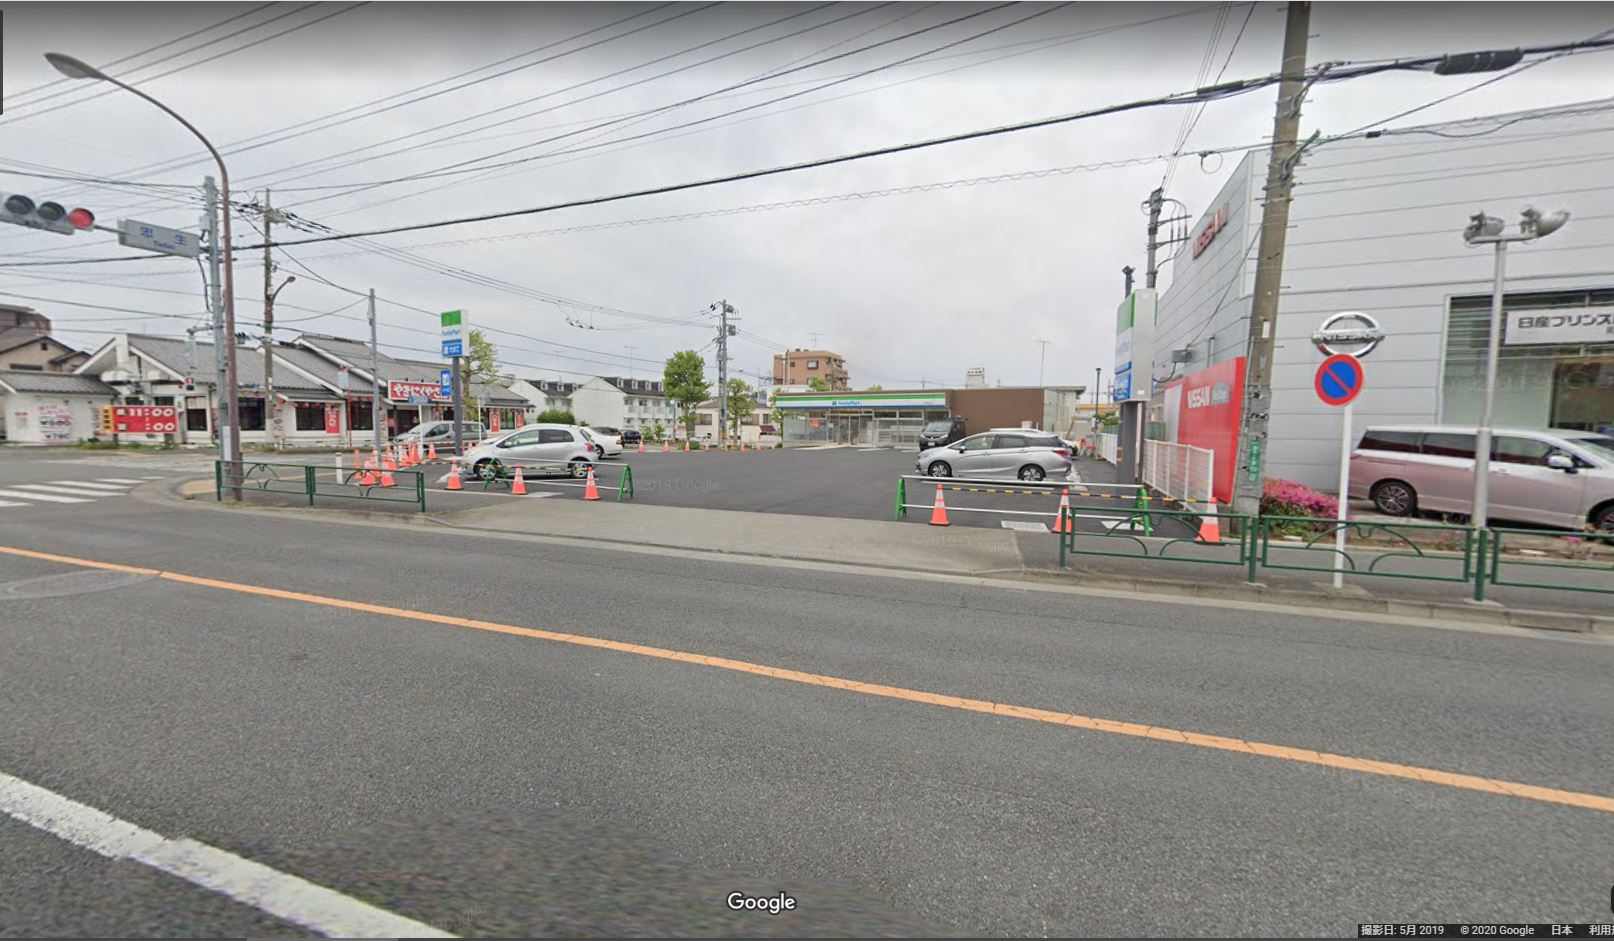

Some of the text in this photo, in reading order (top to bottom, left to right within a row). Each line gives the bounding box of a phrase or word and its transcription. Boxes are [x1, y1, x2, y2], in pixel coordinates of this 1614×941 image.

[1518, 313, 1614, 329] 日産プリンス
[393, 383, 450, 399] やきにくやさ
